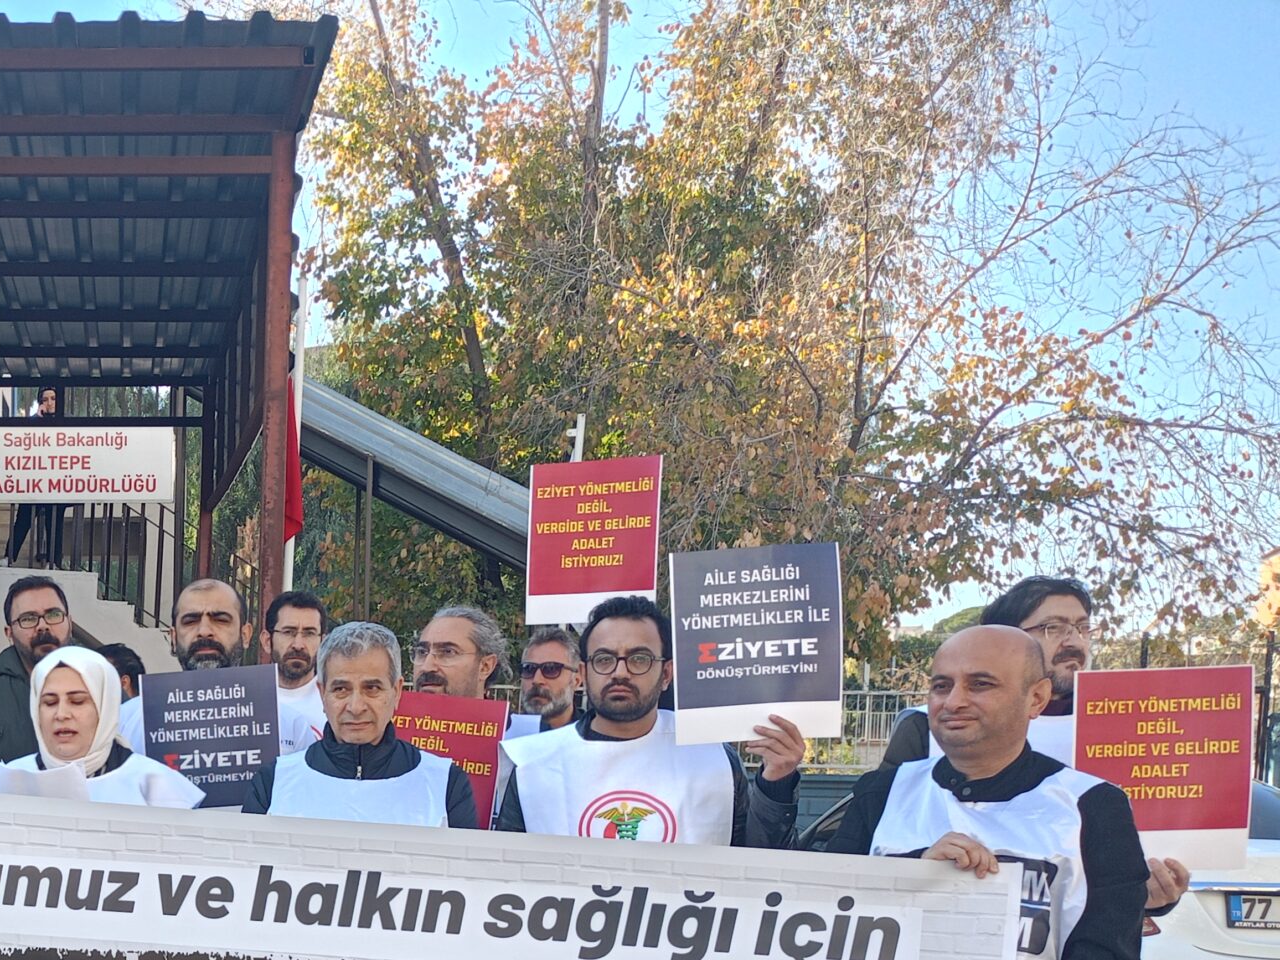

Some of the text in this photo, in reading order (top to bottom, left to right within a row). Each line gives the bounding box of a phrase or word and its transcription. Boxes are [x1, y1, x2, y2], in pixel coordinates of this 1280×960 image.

[3, 432, 50, 450] Sağlık
[57, 431, 128, 450] Bakanlığı
[4, 455, 91, 471] KIZILTEPE
[48, 474, 157, 493] MÜDÜRLÜĞÜ
[537, 476, 654, 499] EZİYET YÖNETMELİĞİ
[576, 498, 612, 515] DEĞİL,
[536, 514, 652, 534] VERGİDE VE GELİRDE
[571, 536, 615, 550] ADALET
[560, 553, 624, 569] İSTİYORUZ!
[703, 563, 800, 587] AİLE SAĞLIĞI
[699, 584, 810, 608] MERKEZLERİNİ
[681, 606, 830, 631] YÖNETMELİKLER İLE
[696, 661, 818, 680] DÖNÜŞTÜRMEYİN!
[167, 683, 246, 704] AİLE SAĞLIĞI
[1086, 693, 1241, 715] EZİYET YÖNETMELİĞİ
[163, 702, 254, 723] MERKEZLERİNİ
[149, 720, 271, 743] YÖNETMELİKLER İLE
[414, 715, 499, 737] YÖNETMELİĞİ
[1136, 717, 1185, 735] DEĞİL,
[1085, 737, 1240, 758] VERGİDE VE GELİRDE
[1130, 763, 1190, 778] ADALET
[157, 872, 234, 919] ve
[250, 864, 466, 935] halkın
[1242, 898, 1272, 920] 77
